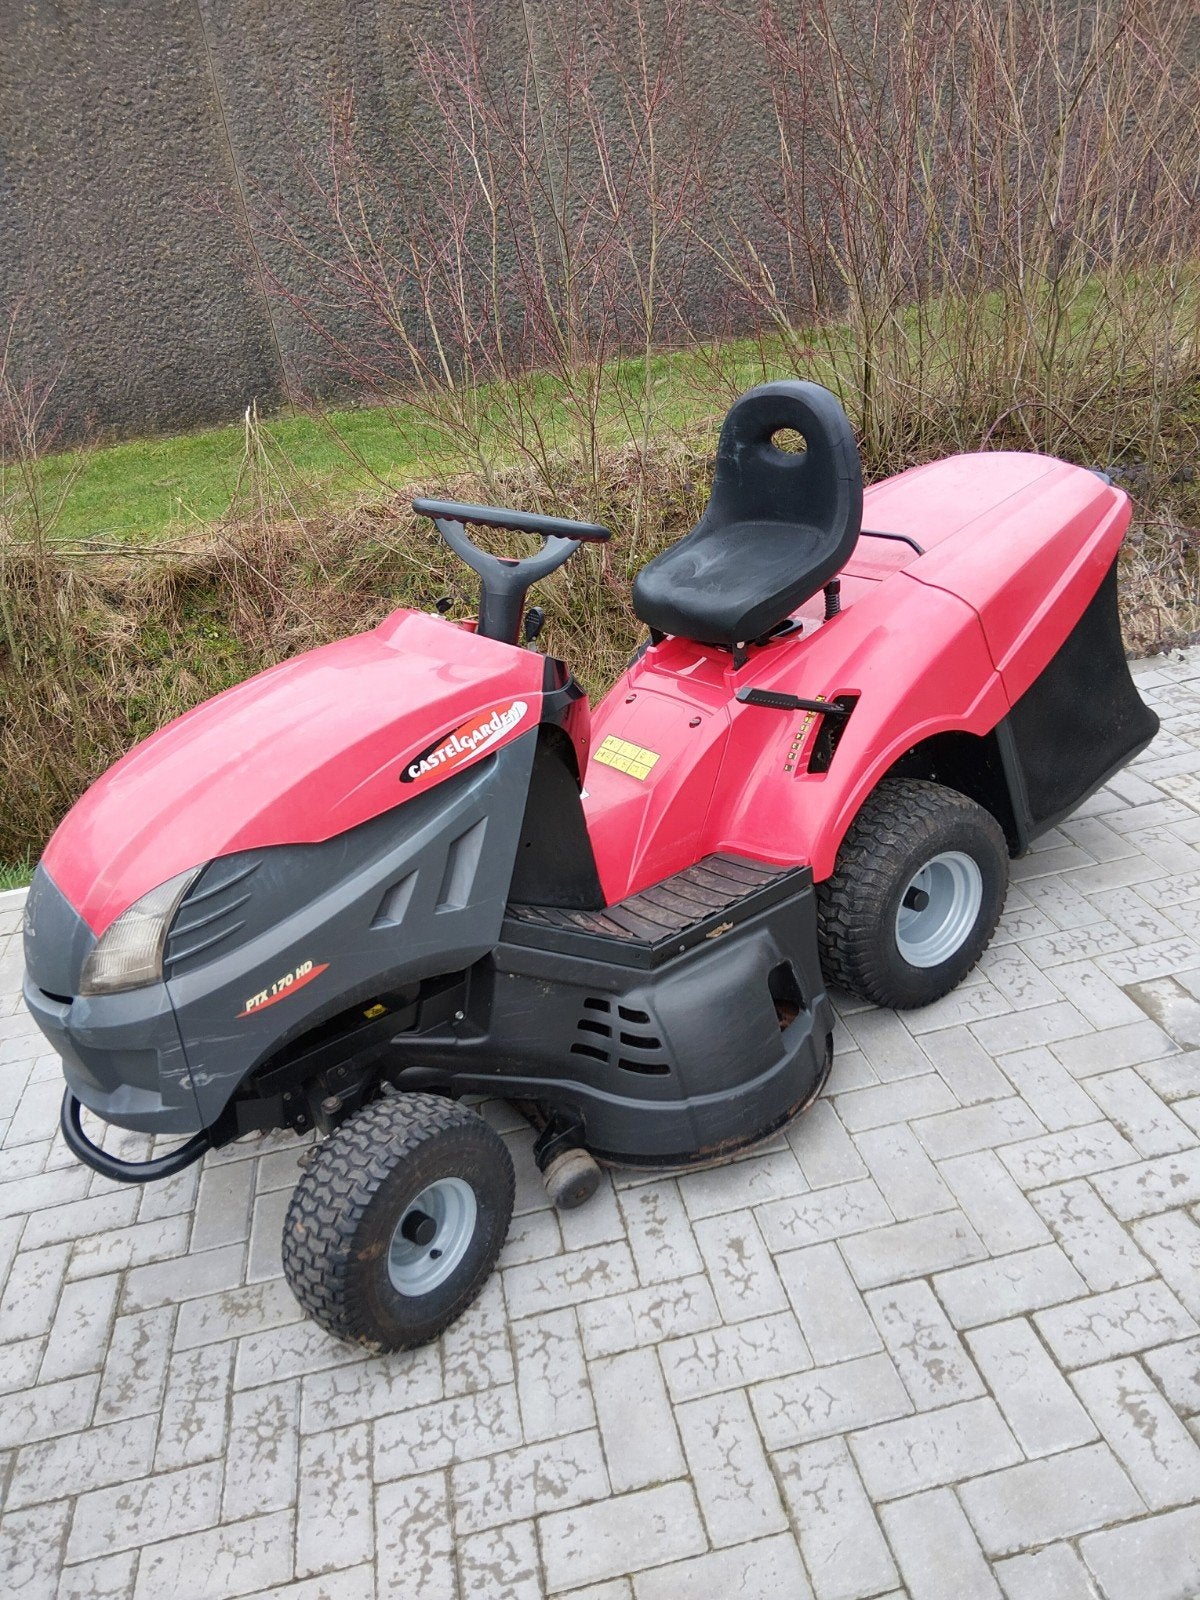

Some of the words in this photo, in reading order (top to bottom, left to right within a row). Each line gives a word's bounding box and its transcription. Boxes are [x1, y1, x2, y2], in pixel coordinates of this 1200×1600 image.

[245, 989, 269, 1012] PTX
[271, 973, 294, 995] 170
[295, 960, 313, 979] HD
